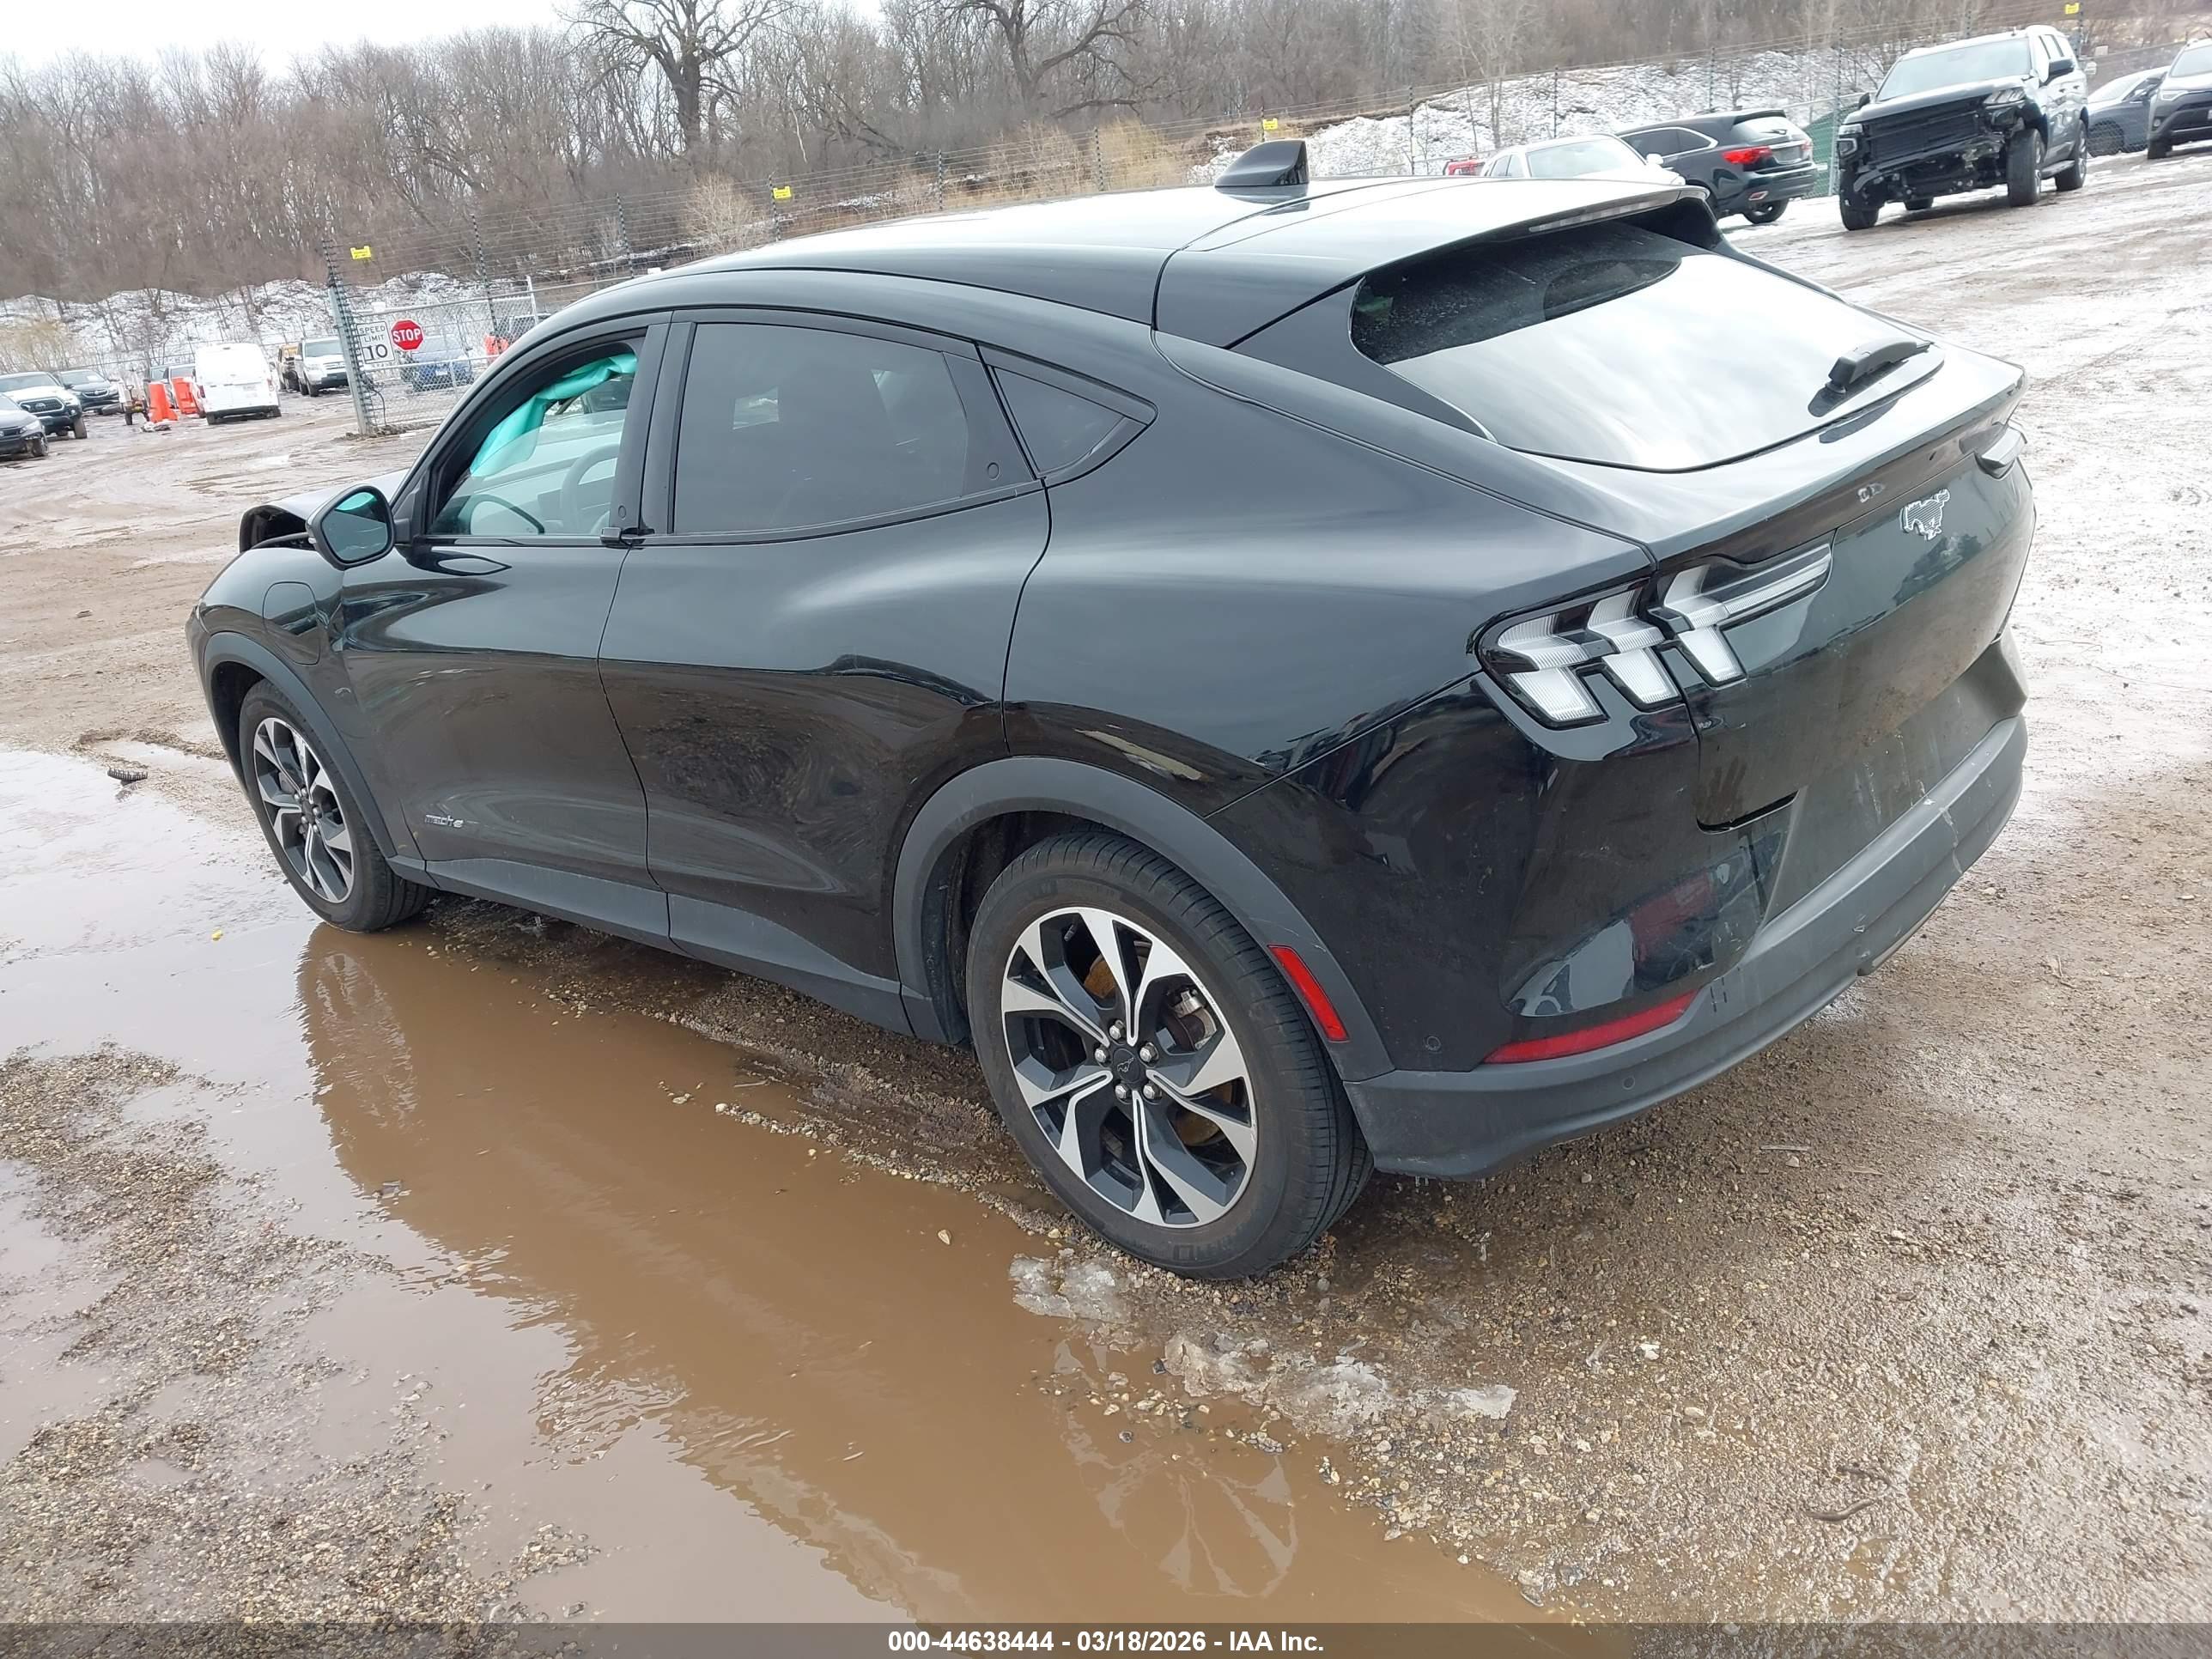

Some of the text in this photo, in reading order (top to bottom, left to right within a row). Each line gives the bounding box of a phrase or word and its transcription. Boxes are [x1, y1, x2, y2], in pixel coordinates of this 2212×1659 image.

[359, 325, 386, 334] SPEED
[392, 328, 421, 343] STOP
[364, 344, 388, 361] 10
